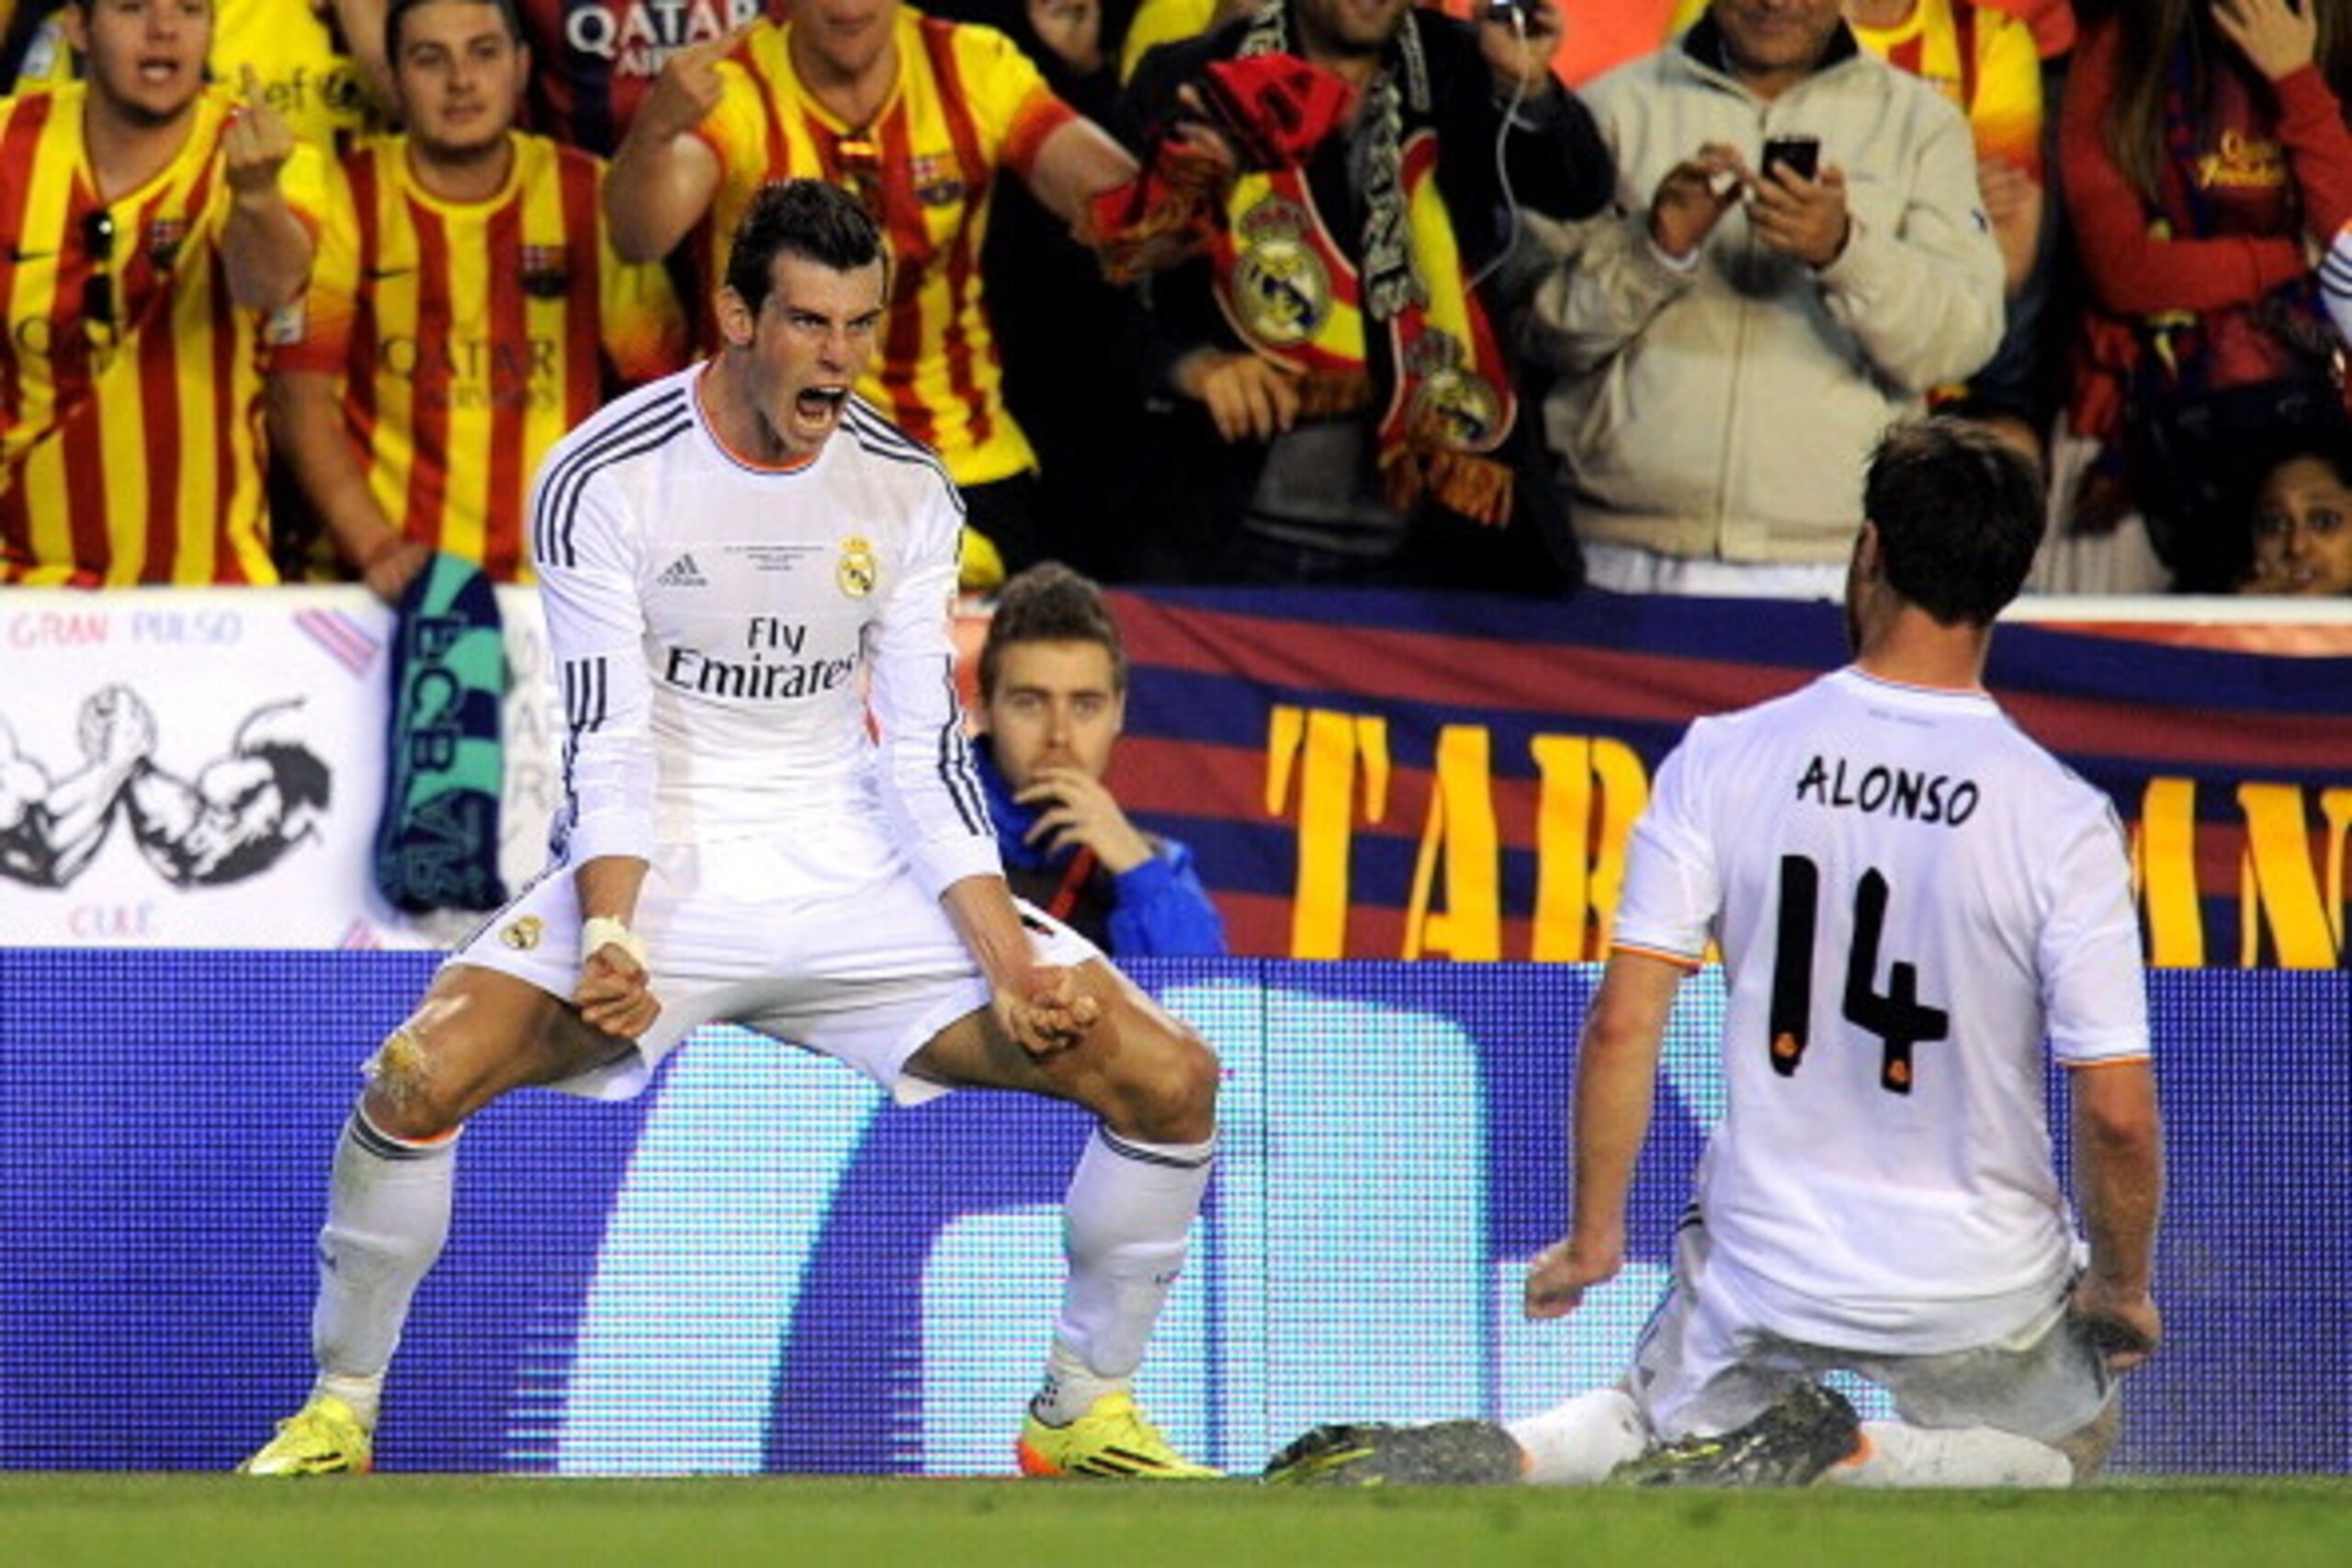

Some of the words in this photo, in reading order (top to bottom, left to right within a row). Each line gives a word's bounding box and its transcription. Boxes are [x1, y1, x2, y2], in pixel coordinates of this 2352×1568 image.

[7, 612, 108, 650] GRAN
[131, 609, 243, 643] PULSO
[747, 616, 806, 657] Fly
[1796, 754, 1981, 828] ALONSO
[1769, 853, 1950, 1096] 14
